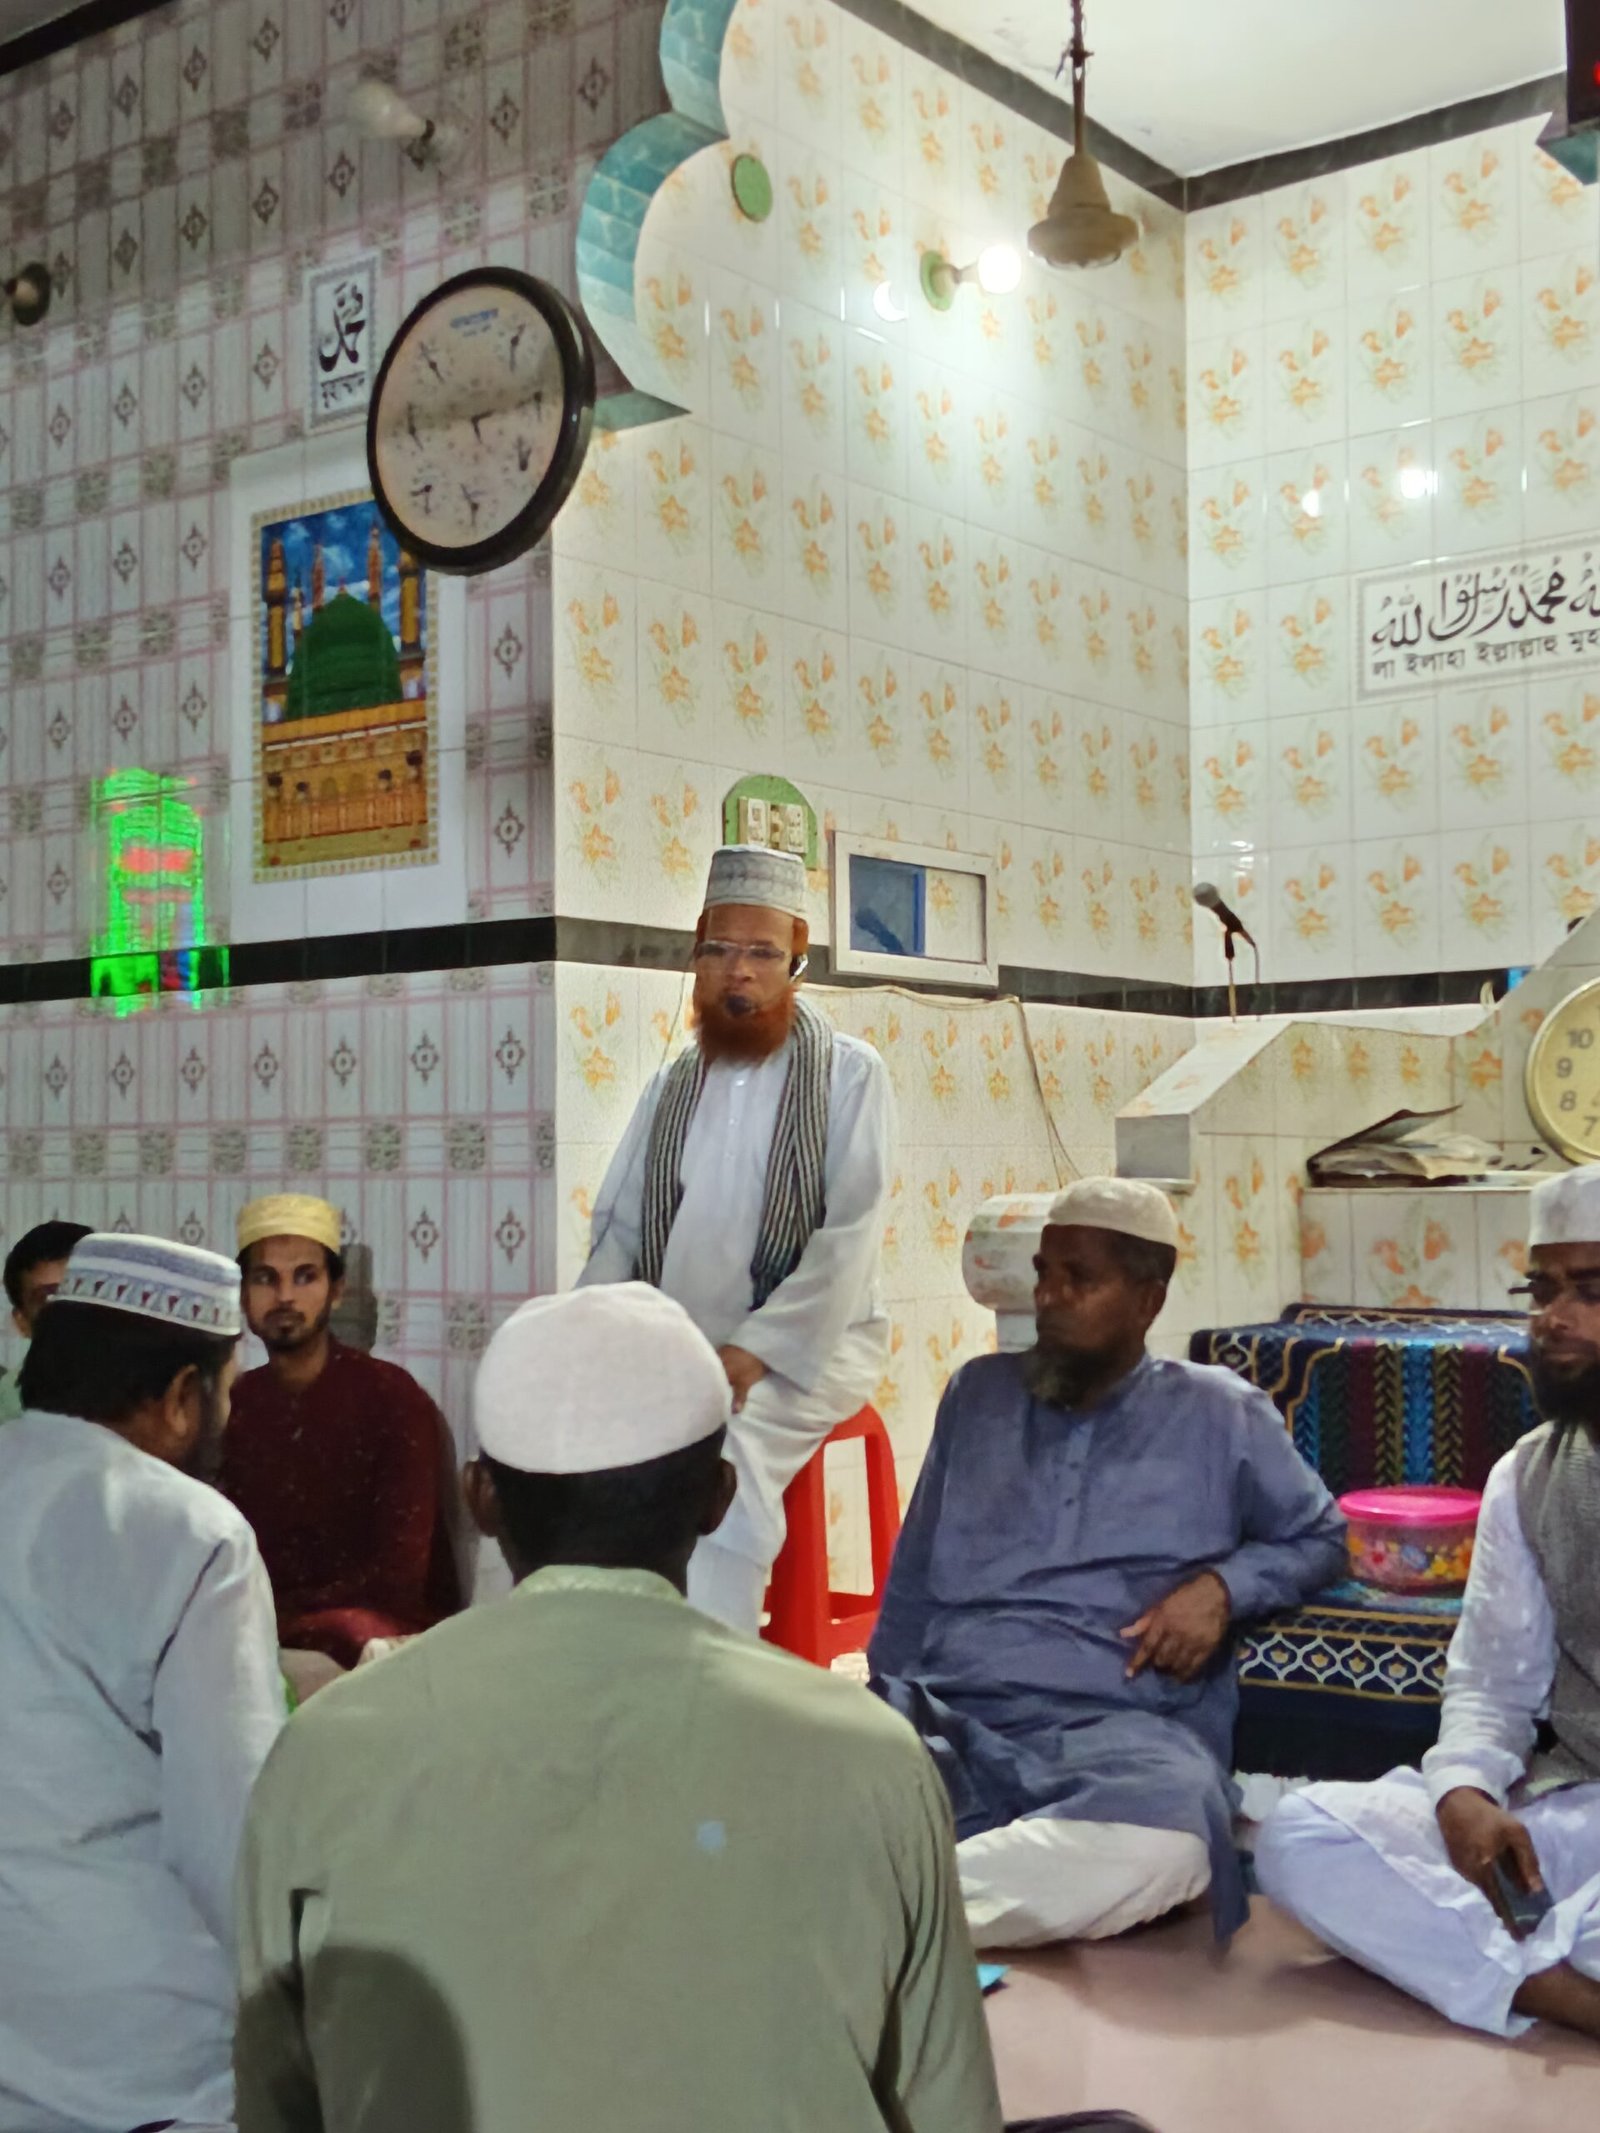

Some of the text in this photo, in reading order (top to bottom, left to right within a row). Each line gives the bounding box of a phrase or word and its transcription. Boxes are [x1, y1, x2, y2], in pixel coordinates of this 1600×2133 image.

[1372, 659, 1395, 679] লা
[1567, 1028, 1594, 1049] 10
[1557, 1057, 1573, 1078] 9
[1560, 1090, 1576, 1111] 8
[1582, 1116, 1598, 1137] 7
